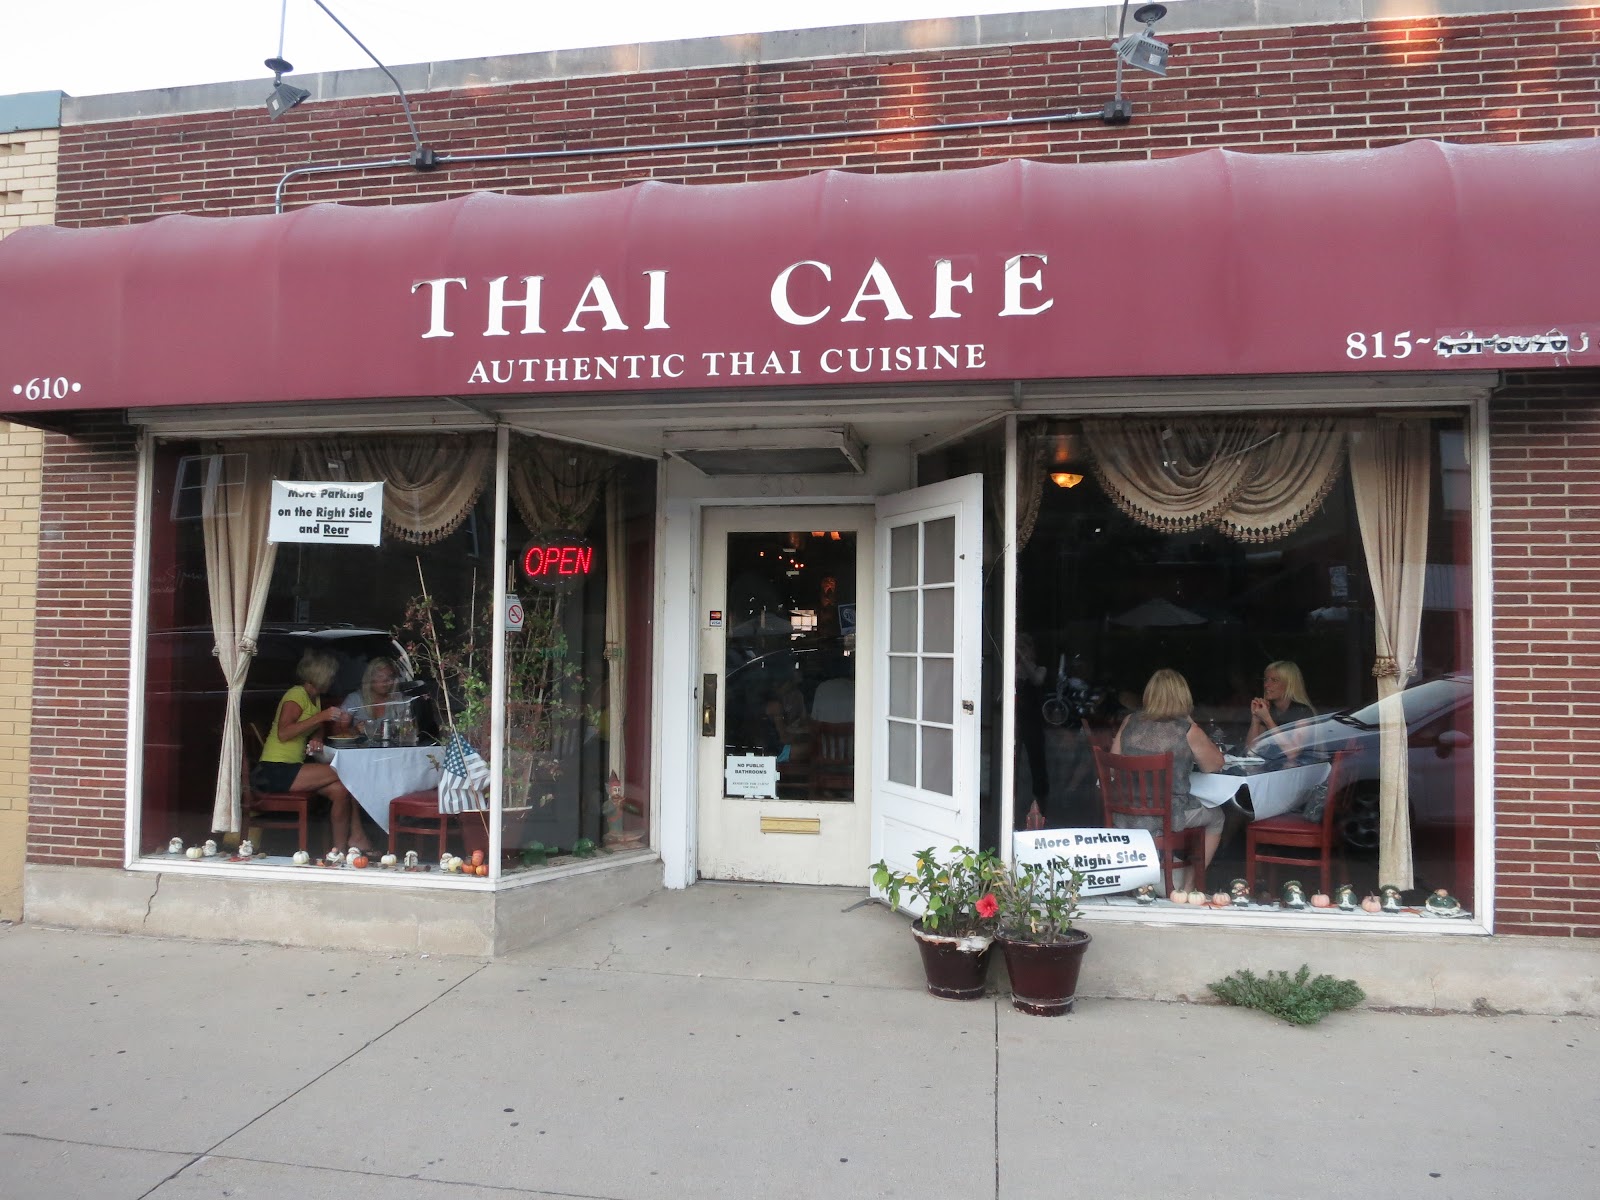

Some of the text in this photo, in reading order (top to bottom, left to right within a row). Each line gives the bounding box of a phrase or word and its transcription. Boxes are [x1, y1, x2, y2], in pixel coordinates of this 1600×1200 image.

[411, 253, 1054, 338] THAI CAFE
[467, 343, 987, 383] AUTHENTIC THAI CUISINE
[288, 489, 364, 501] More Parking
[278, 506, 373, 519] on the Right Side
[299, 524, 349, 535] and Rear
[525, 547, 592, 576] OPEN
[1034, 833, 1131, 850] More Parking
[1046, 857, 1070, 870] th
[1074, 853, 1112, 870] Right
[1116, 850, 1147, 864] Side
[1087, 874, 1121, 886] Rear
